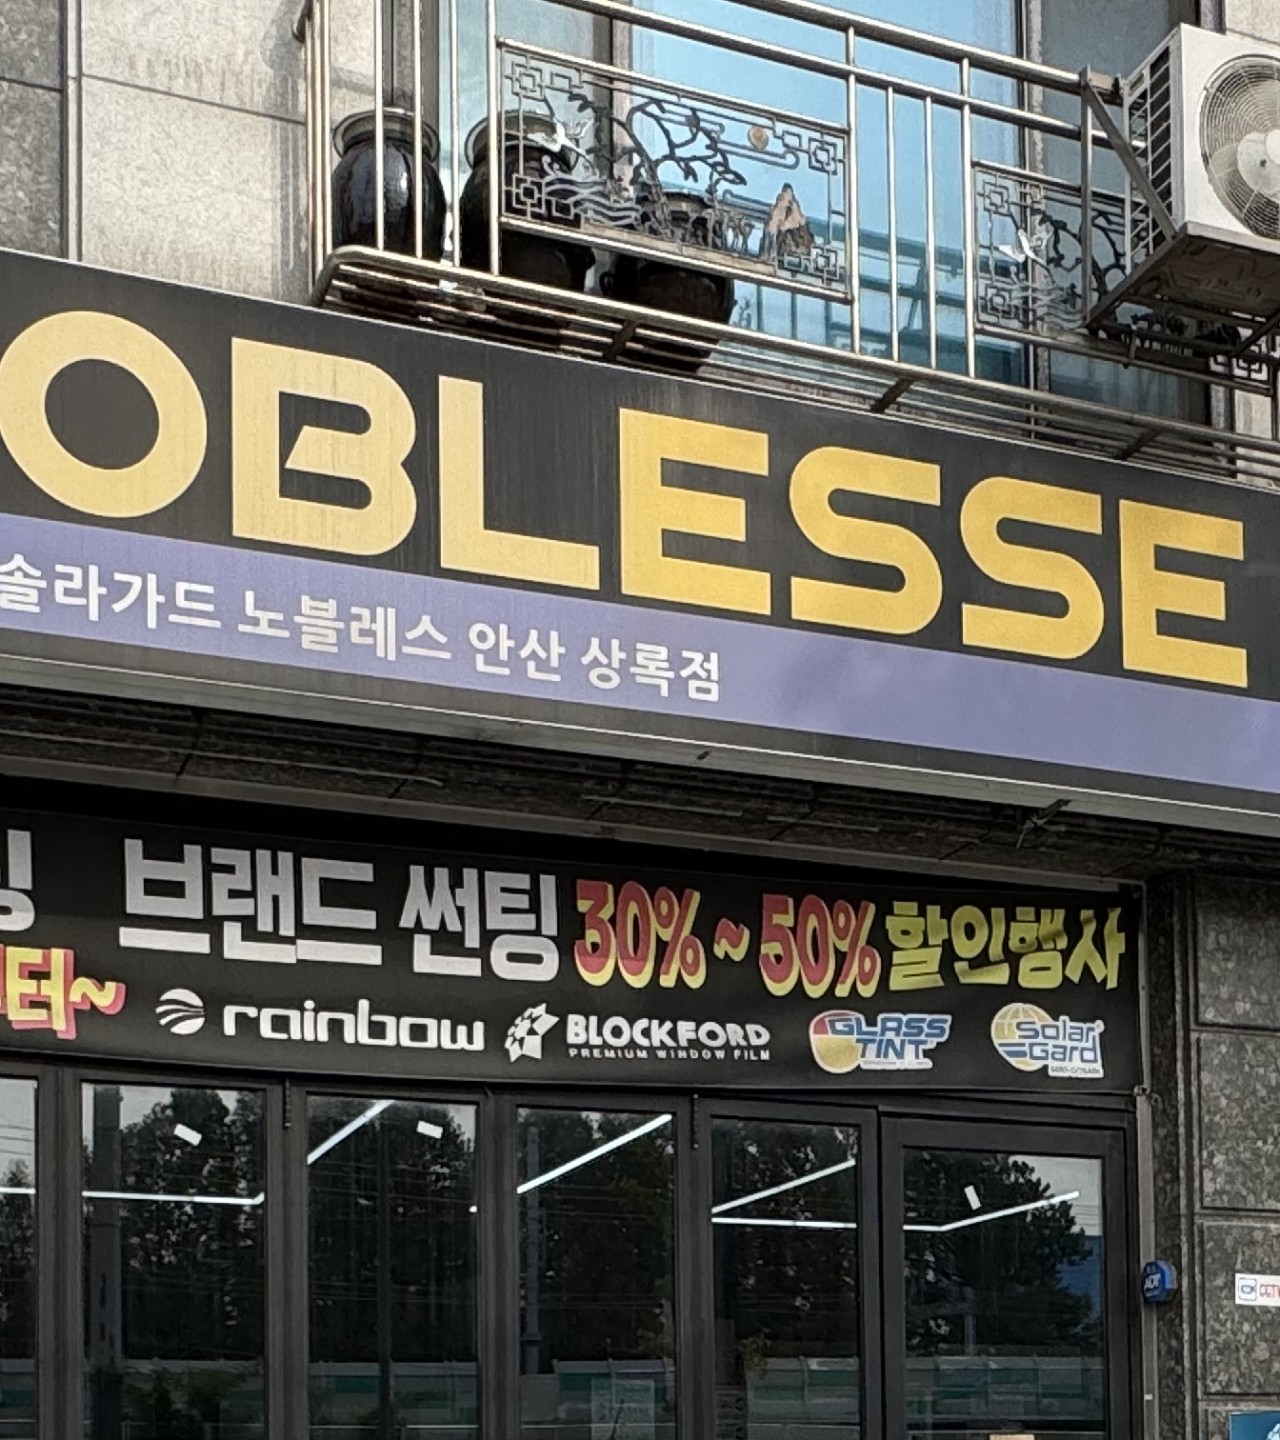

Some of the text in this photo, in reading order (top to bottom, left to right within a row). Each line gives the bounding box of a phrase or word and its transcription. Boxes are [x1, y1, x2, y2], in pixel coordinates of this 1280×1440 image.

[237, 588, 453, 663] 노블레스
[468, 620, 567, 683] 안산
[580, 641, 721, 702] 상록점
[118, 837, 384, 967] 브랜드
[399, 862, 560, 983] 썬팅
[884, 900, 1127, 993] 할인행사
[223, 998, 486, 1052] rainbow
[565, 1012, 772, 1048] BLOCKFORD
[827, 1015, 949, 1038] GLASS
[1015, 1018, 1096, 1043] Solar
[568, 1048, 771, 1061] PREMIUM WINDOW FILM
[855, 1037, 928, 1060] TINT
[1027, 1035, 1099, 1063] Gard
